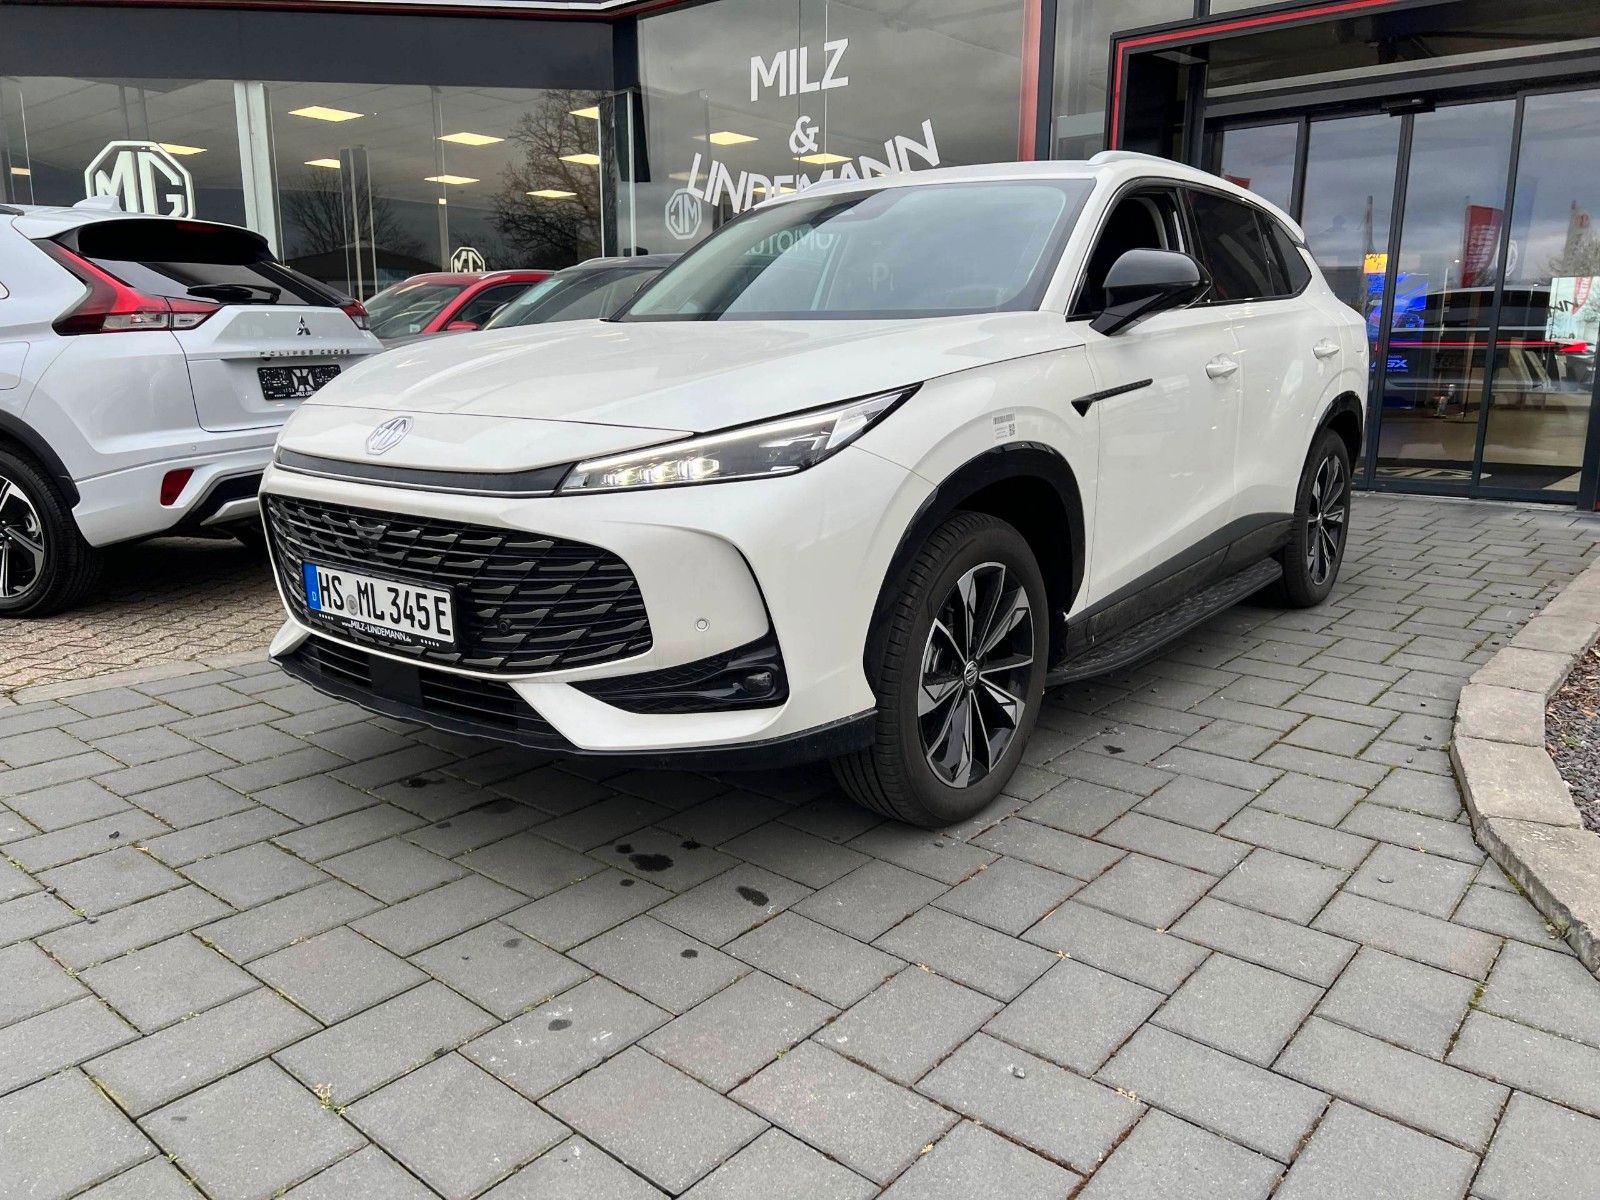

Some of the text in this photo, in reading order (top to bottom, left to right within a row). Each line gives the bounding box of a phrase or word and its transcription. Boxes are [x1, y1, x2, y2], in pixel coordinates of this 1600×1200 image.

[750, 38, 849, 102] MILZ
[788, 115, 819, 154] &
[95, 150, 186, 217] MG
[318, 571, 345, 611] HS
[356, 580, 385, 621] ML
